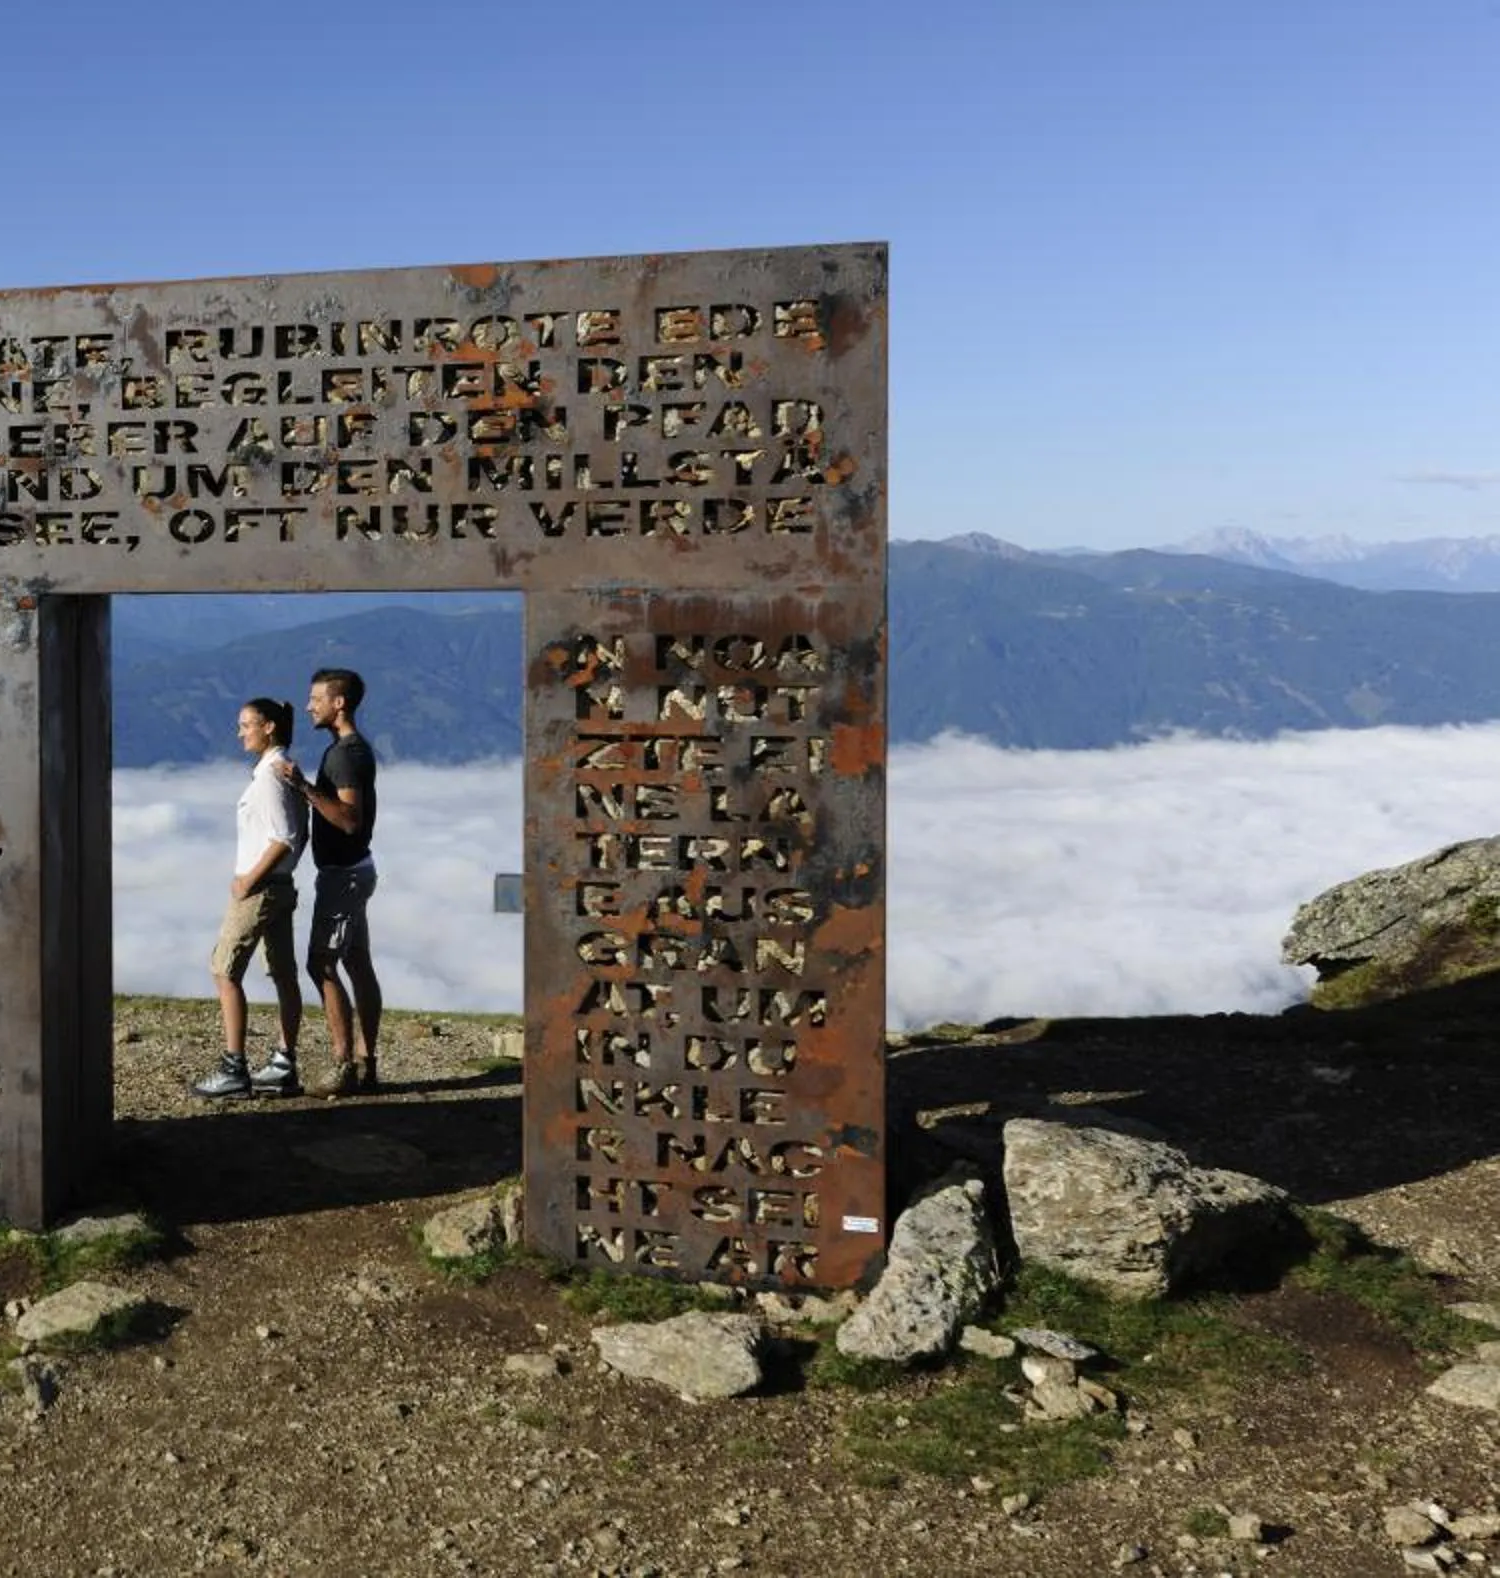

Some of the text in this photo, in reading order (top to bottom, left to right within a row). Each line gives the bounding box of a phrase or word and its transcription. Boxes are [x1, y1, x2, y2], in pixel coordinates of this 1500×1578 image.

[165, 310, 620, 364] RUBINROTE
[655, 300, 819, 344] EDE
[121, 360, 541, 410] BEGLEITEN
[578, 352, 742, 393] DEN
[227, 413, 378, 453] AUF
[410, 407, 567, 446] DEN
[604, 400, 824, 440] PFAD
[133, 463, 248, 498] UM
[281, 457, 432, 495] DEN
[169, 508, 307, 544] OFT
[337, 504, 497, 540] NUR
[529, 497, 813, 536] VERDE
[656, 634, 826, 673] NOA
[658, 685, 822, 723] NUT
[576, 733, 725, 771] ZTE
[576, 783, 816, 824] NE LA
[576, 832, 790, 872] TERN
[576, 881, 814, 925] E AUS
[576, 931, 806, 976] GRAN
[702, 986, 827, 1028] UM
[576, 1028, 797, 1075] IN DU
[576, 1078, 789, 1125] NKLE
[576, 1127, 824, 1179] R NAC
[691, 1184, 820, 1229] SEI
